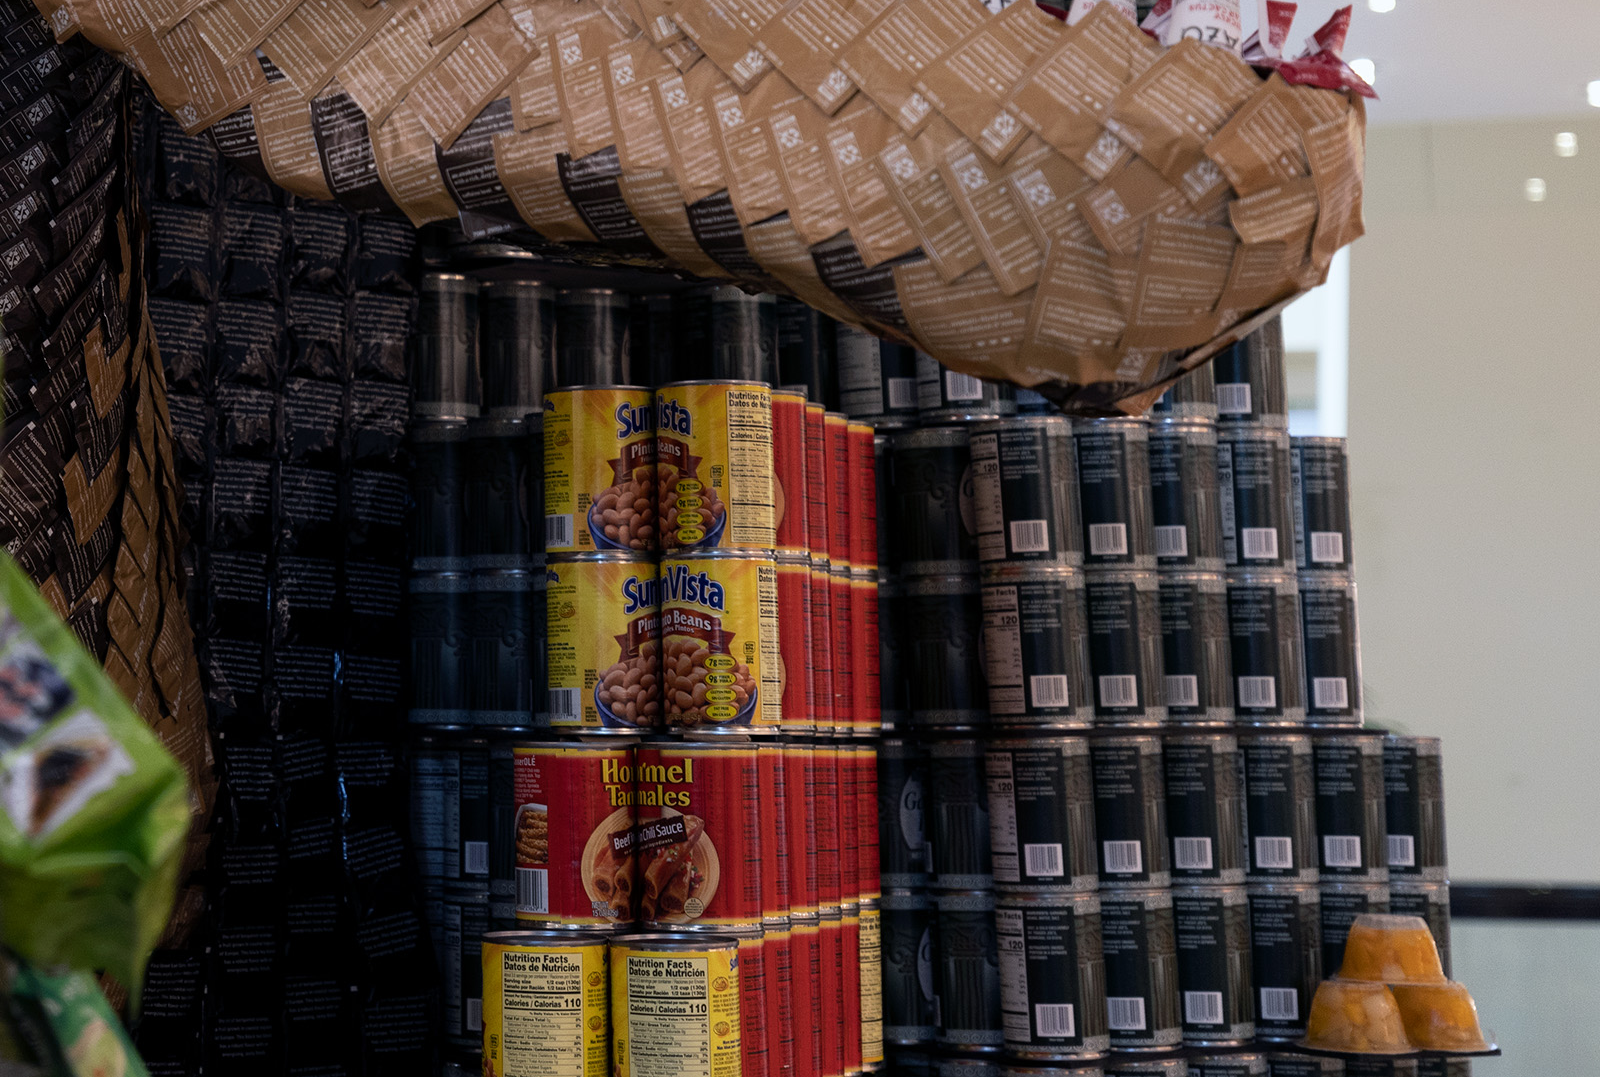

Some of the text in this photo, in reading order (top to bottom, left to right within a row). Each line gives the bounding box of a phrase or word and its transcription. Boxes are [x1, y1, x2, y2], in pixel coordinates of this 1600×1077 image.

[729, 391, 759, 401] Nutrition
[729, 399, 750, 408] Datos
[983, 464, 998, 473] 120
[673, 610, 712, 632] Beans
[1001, 616, 1018, 625] 120
[674, 624, 695, 634] Pintos
[613, 820, 683, 850] Beef Sauce
[1008, 940, 1024, 950] 120
[504, 953, 569, 964] Nutrition Facts
[629, 958, 693, 969] Nutrition Facts
[504, 962, 581, 972] Datos de Nutrición
[629, 967, 705, 978] Datos de Nutrición
[504, 998, 581, 1009] Calories Calorias 110
[630, 1003, 707, 1014] Calories Calorias 110
